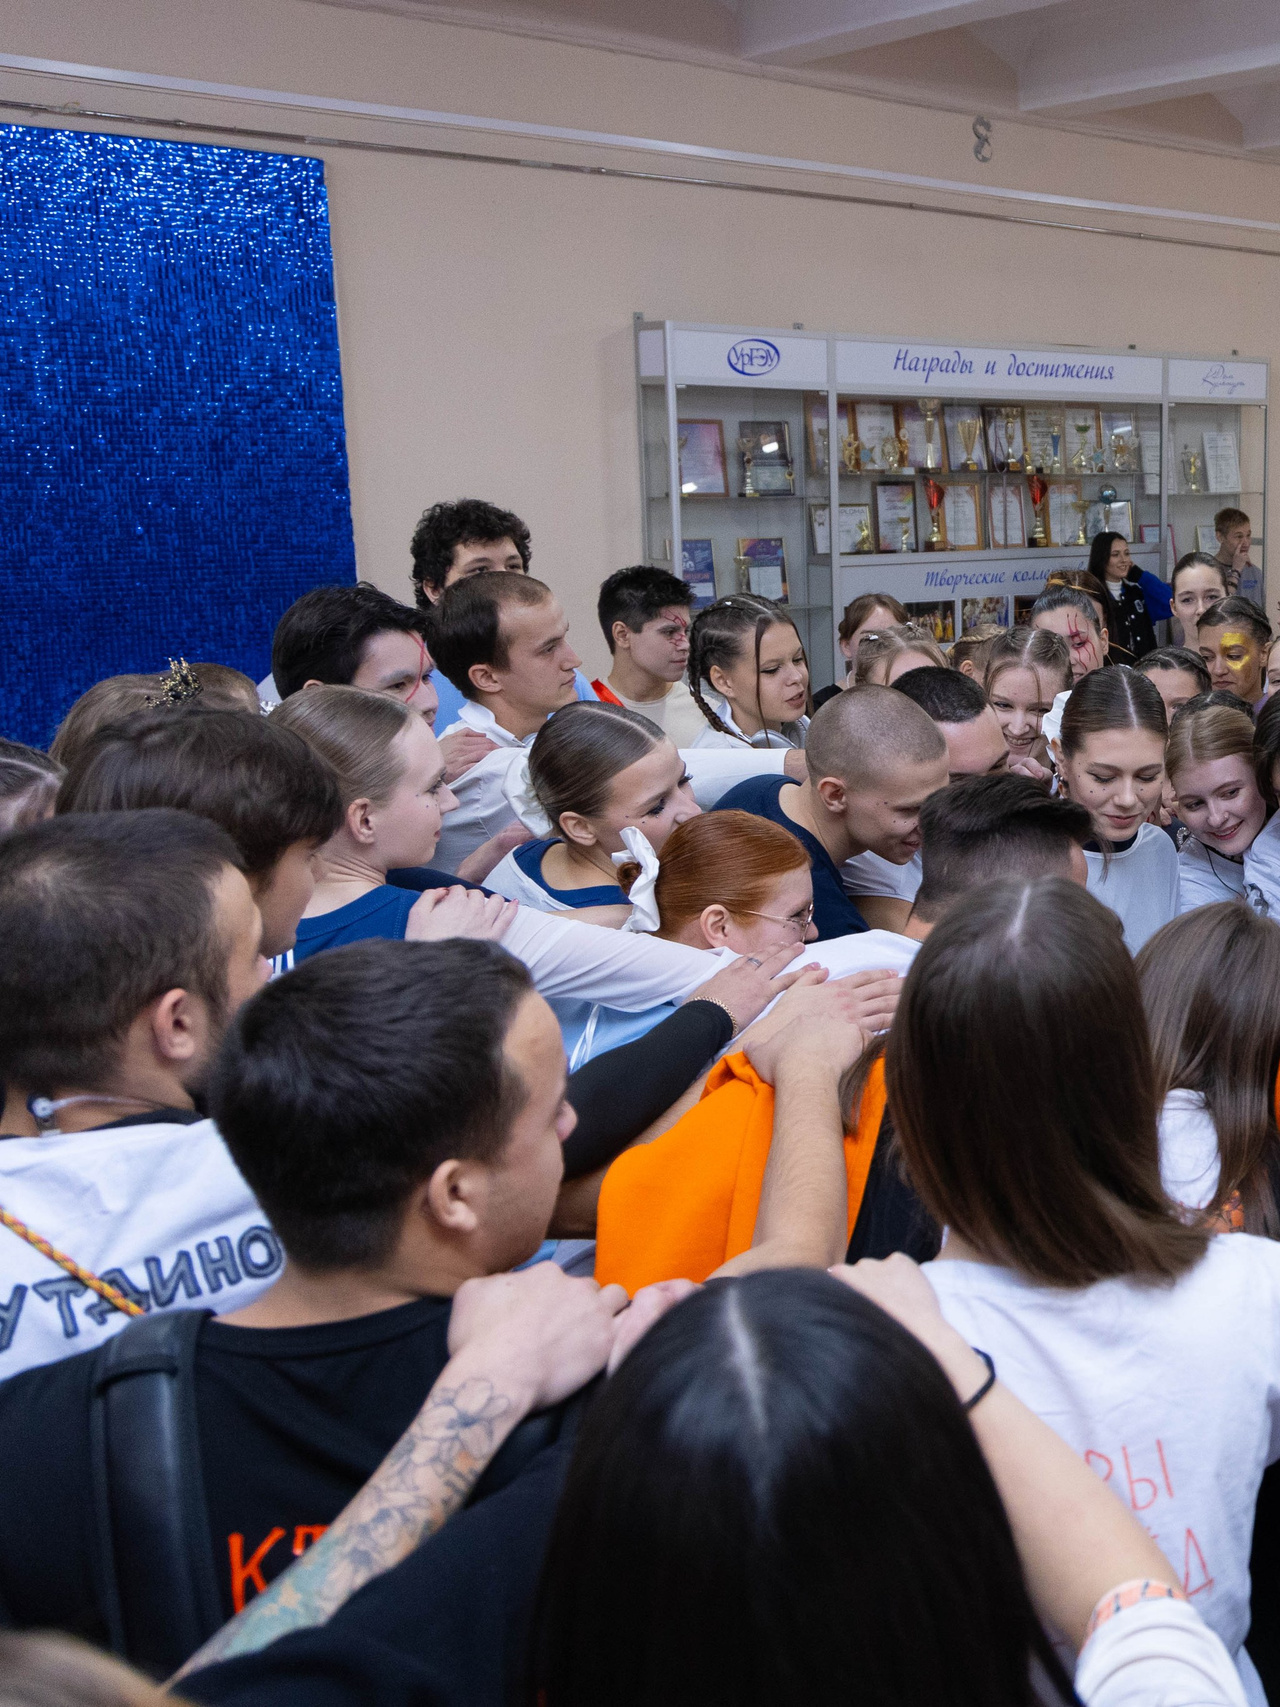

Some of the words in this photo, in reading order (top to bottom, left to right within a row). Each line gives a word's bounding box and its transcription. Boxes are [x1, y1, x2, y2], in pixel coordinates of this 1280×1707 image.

[732, 346, 776, 373] УрГЭУ
[893, 348, 973, 383] Награды
[984, 360, 998, 376] и
[1007, 353, 1114, 381] достижения
[924, 568, 1005, 593] Творческие
